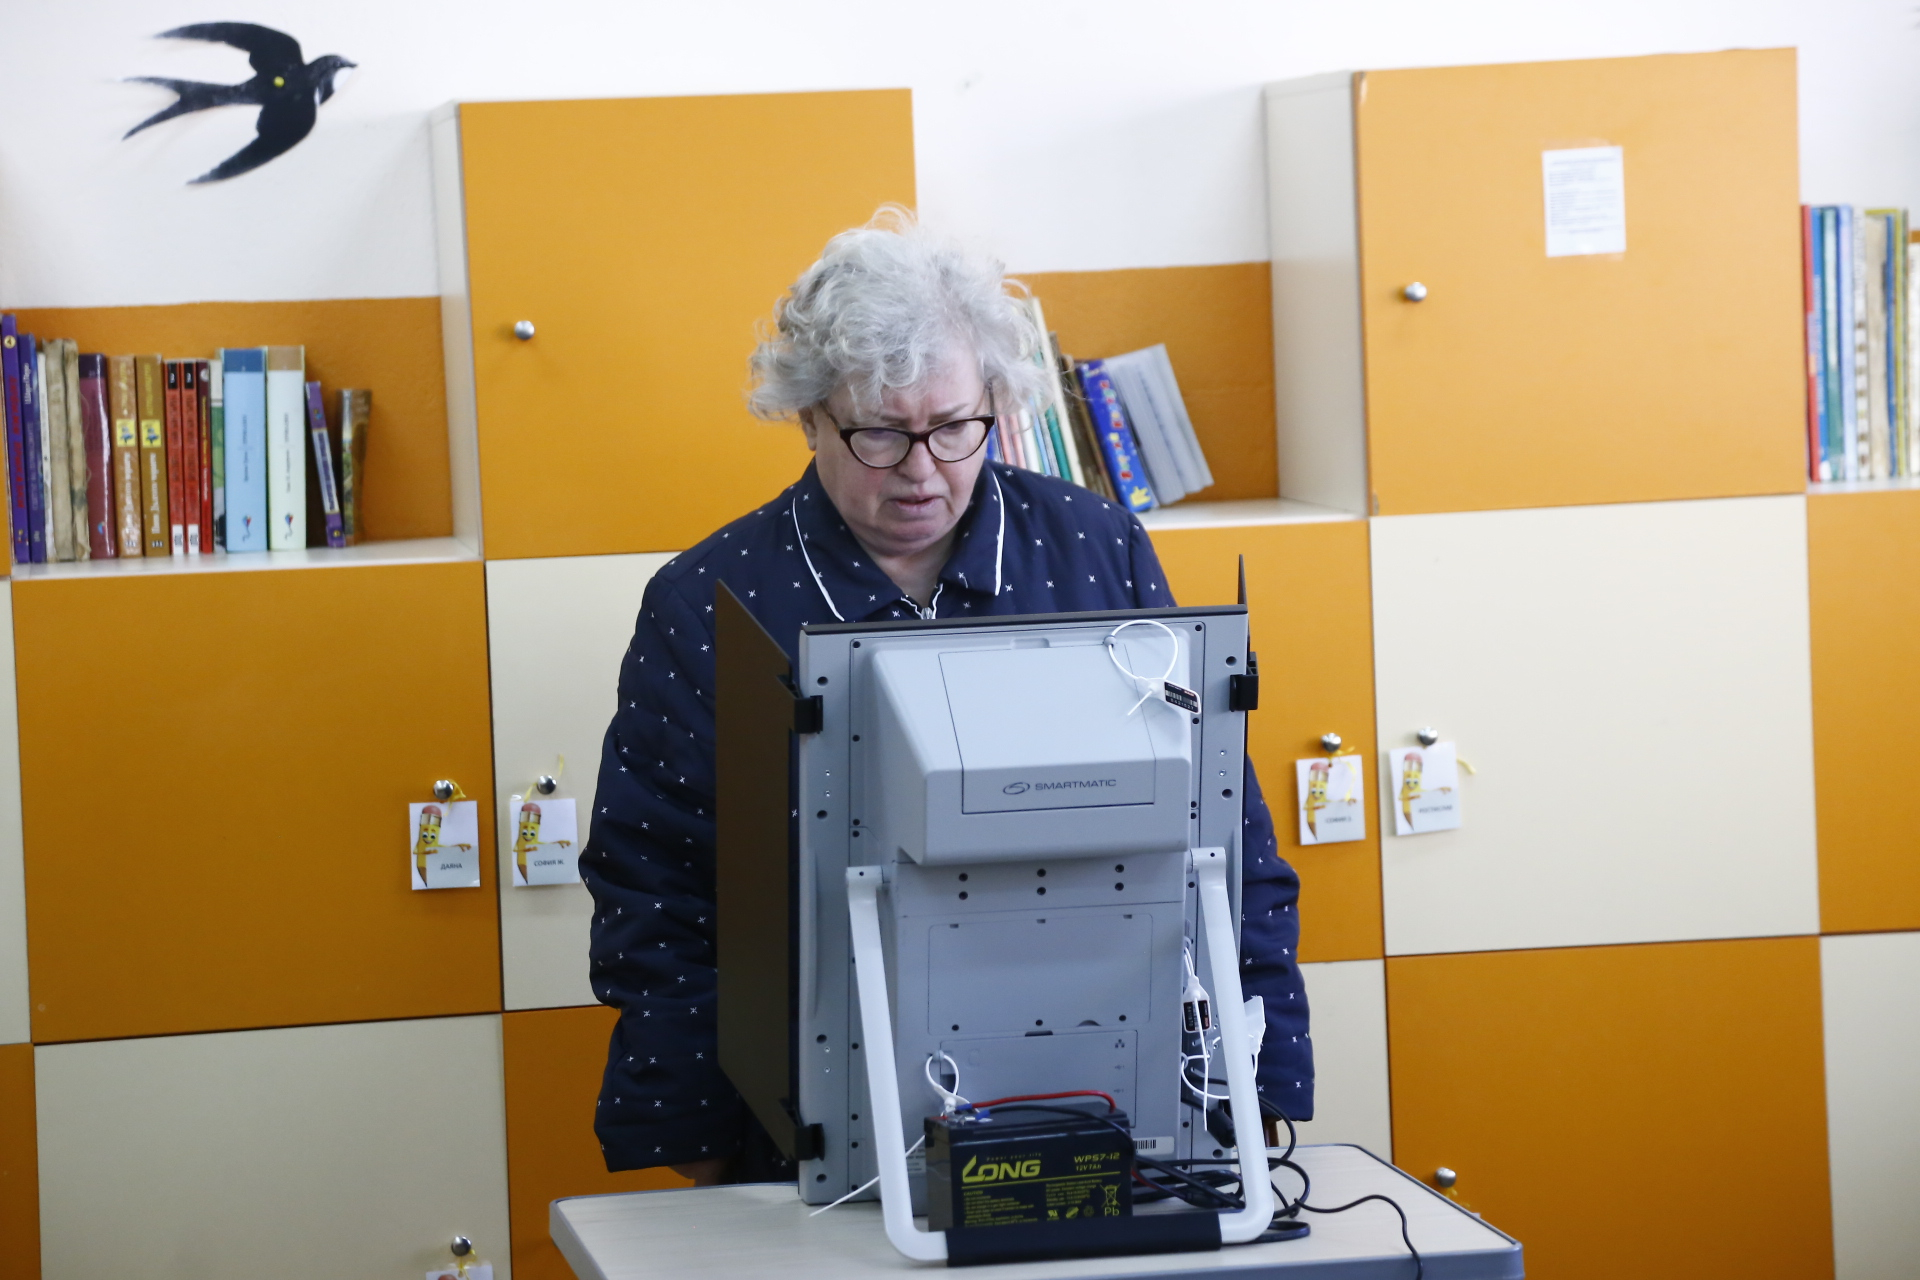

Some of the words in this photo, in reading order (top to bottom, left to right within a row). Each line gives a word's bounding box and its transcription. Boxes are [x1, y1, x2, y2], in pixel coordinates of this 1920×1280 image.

[1035, 779, 1117, 791] SMARTMATIC
[440, 862, 463, 871] ДАЯНА
[534, 859, 557, 867] СОФИЯ
[962, 1155, 1041, 1183] LONG
[1104, 1206, 1121, 1217] Pb
